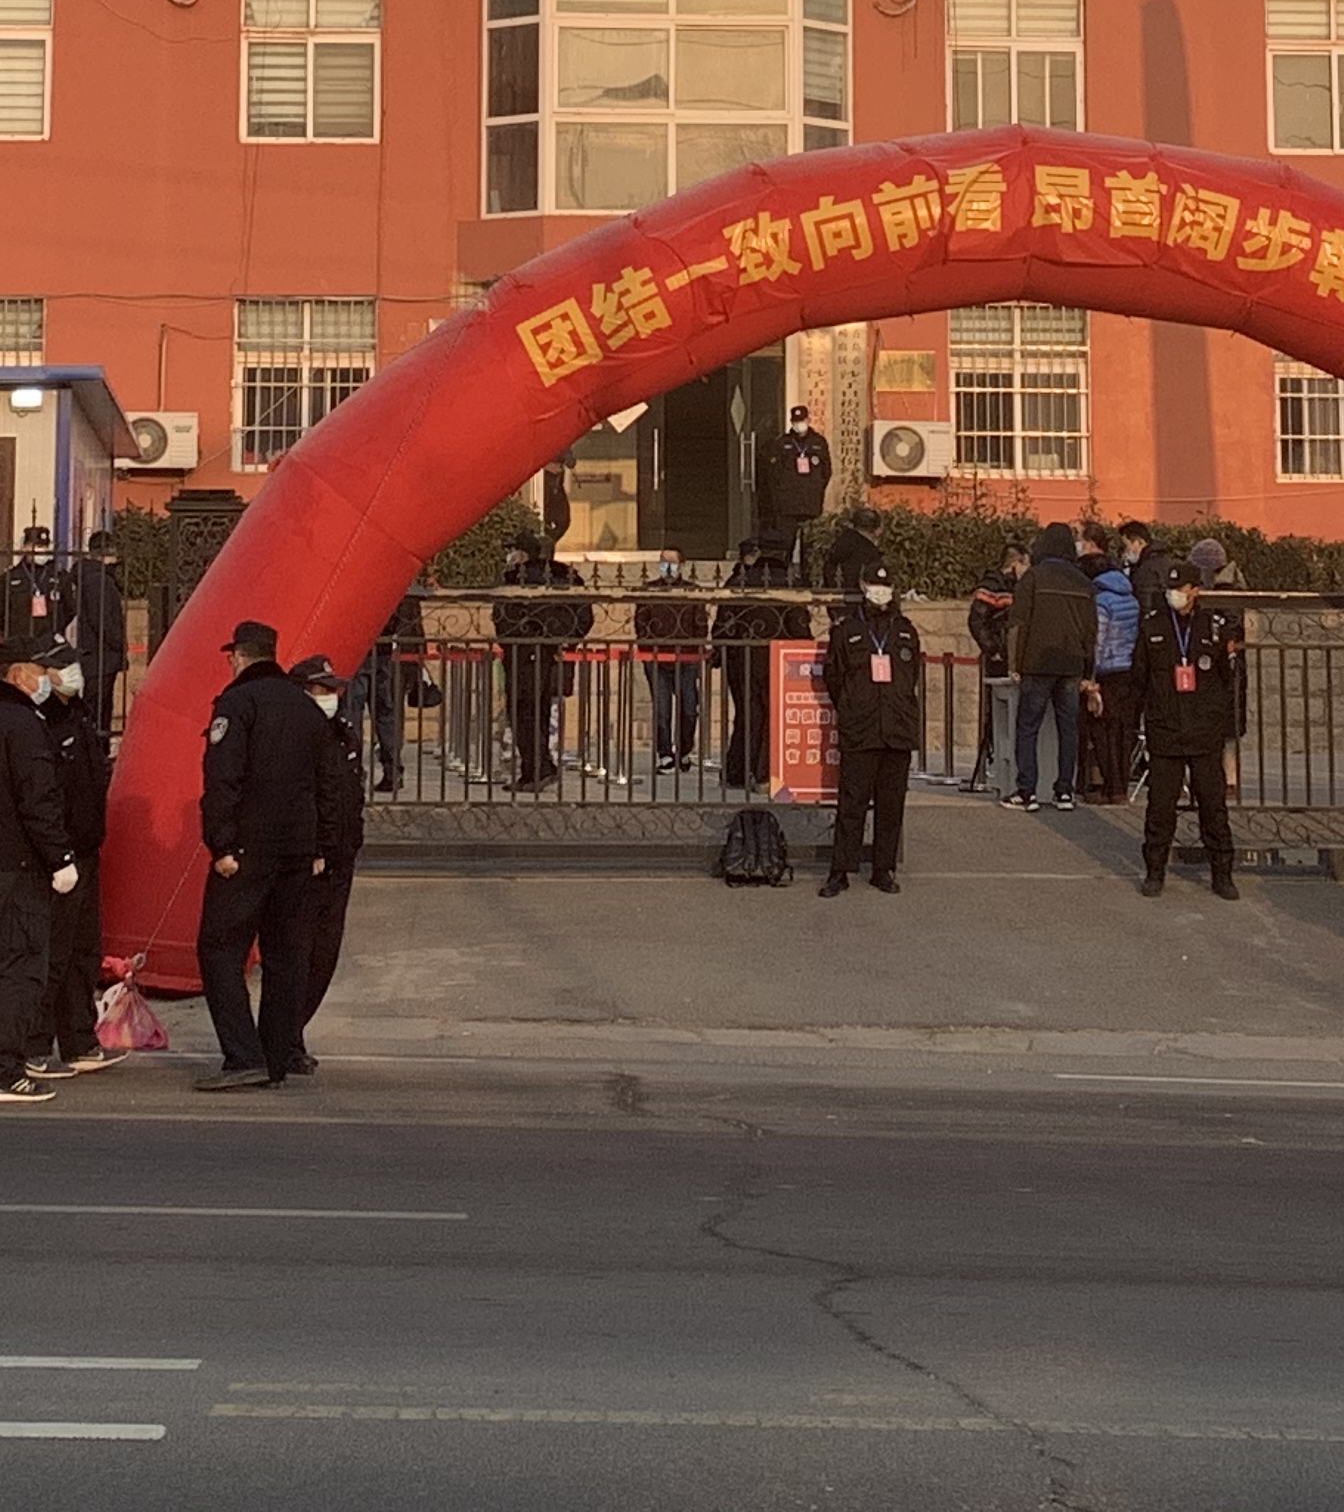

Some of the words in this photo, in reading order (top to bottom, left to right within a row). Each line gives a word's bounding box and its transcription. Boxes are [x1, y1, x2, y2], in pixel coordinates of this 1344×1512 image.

[515, 163, 1008, 388] 团结一致向前看
